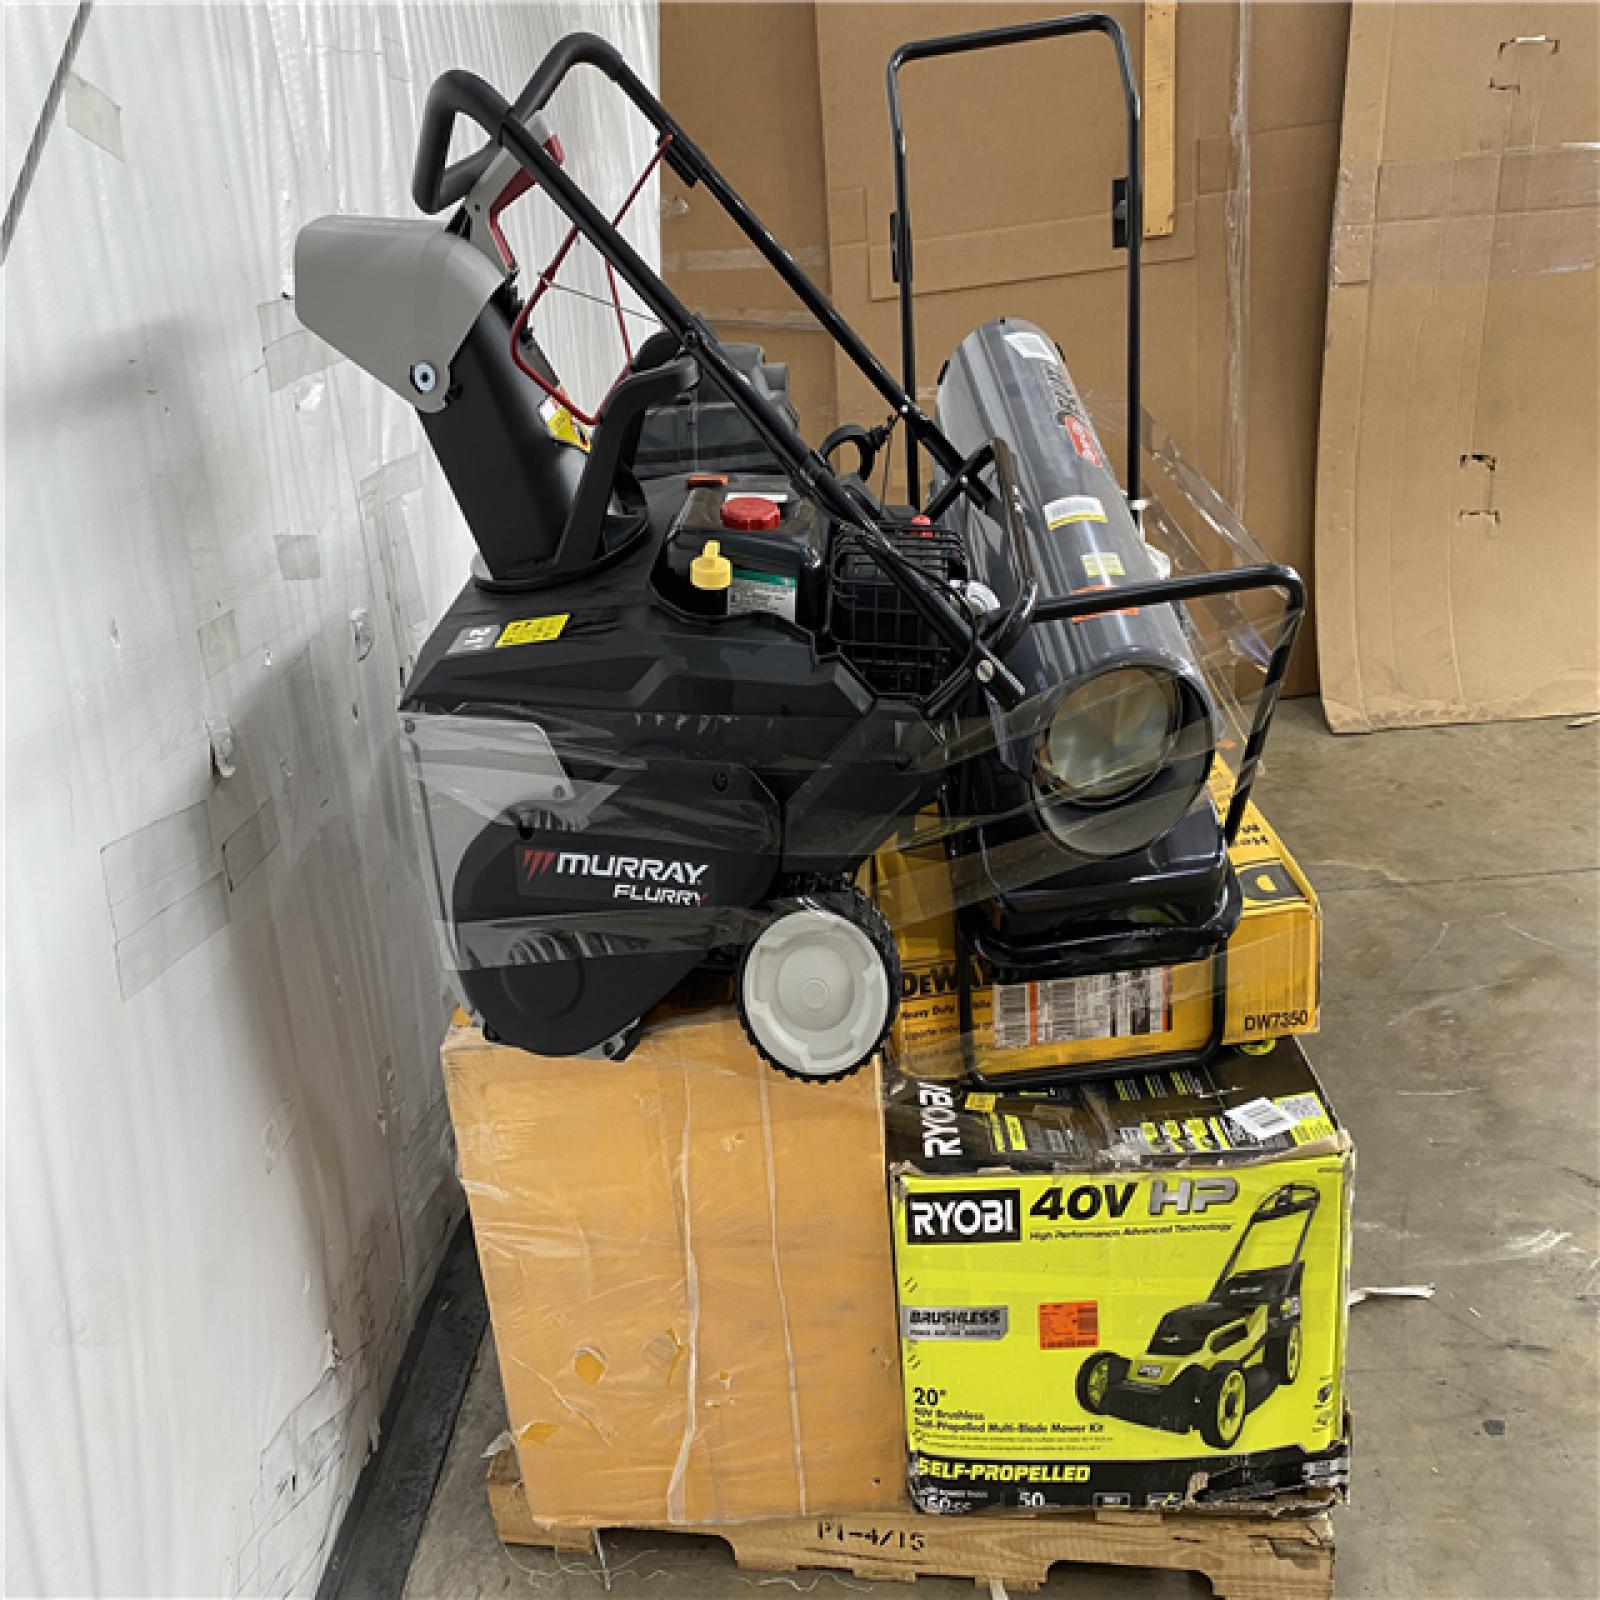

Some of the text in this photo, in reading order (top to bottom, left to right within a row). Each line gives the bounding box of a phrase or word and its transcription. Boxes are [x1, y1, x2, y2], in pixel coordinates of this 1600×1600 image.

[556, 852, 708, 885] MURRAY
[613, 884, 708, 906] FLURRY
[1244, 1009, 1309, 1031] DW7350
[919, 1082, 963, 1158] RYOBI
[1029, 1177, 1240, 1221] 40V HP
[912, 1199, 1014, 1237] RYOBI
[1030, 1231, 1053, 1241] High
[1055, 1229, 1121, 1240] Performance
[909, 1309, 1001, 1325] BRUSHLESS
[913, 1386, 947, 1407] 20"
[917, 1456, 1091, 1482] SELF-PROPELLED
